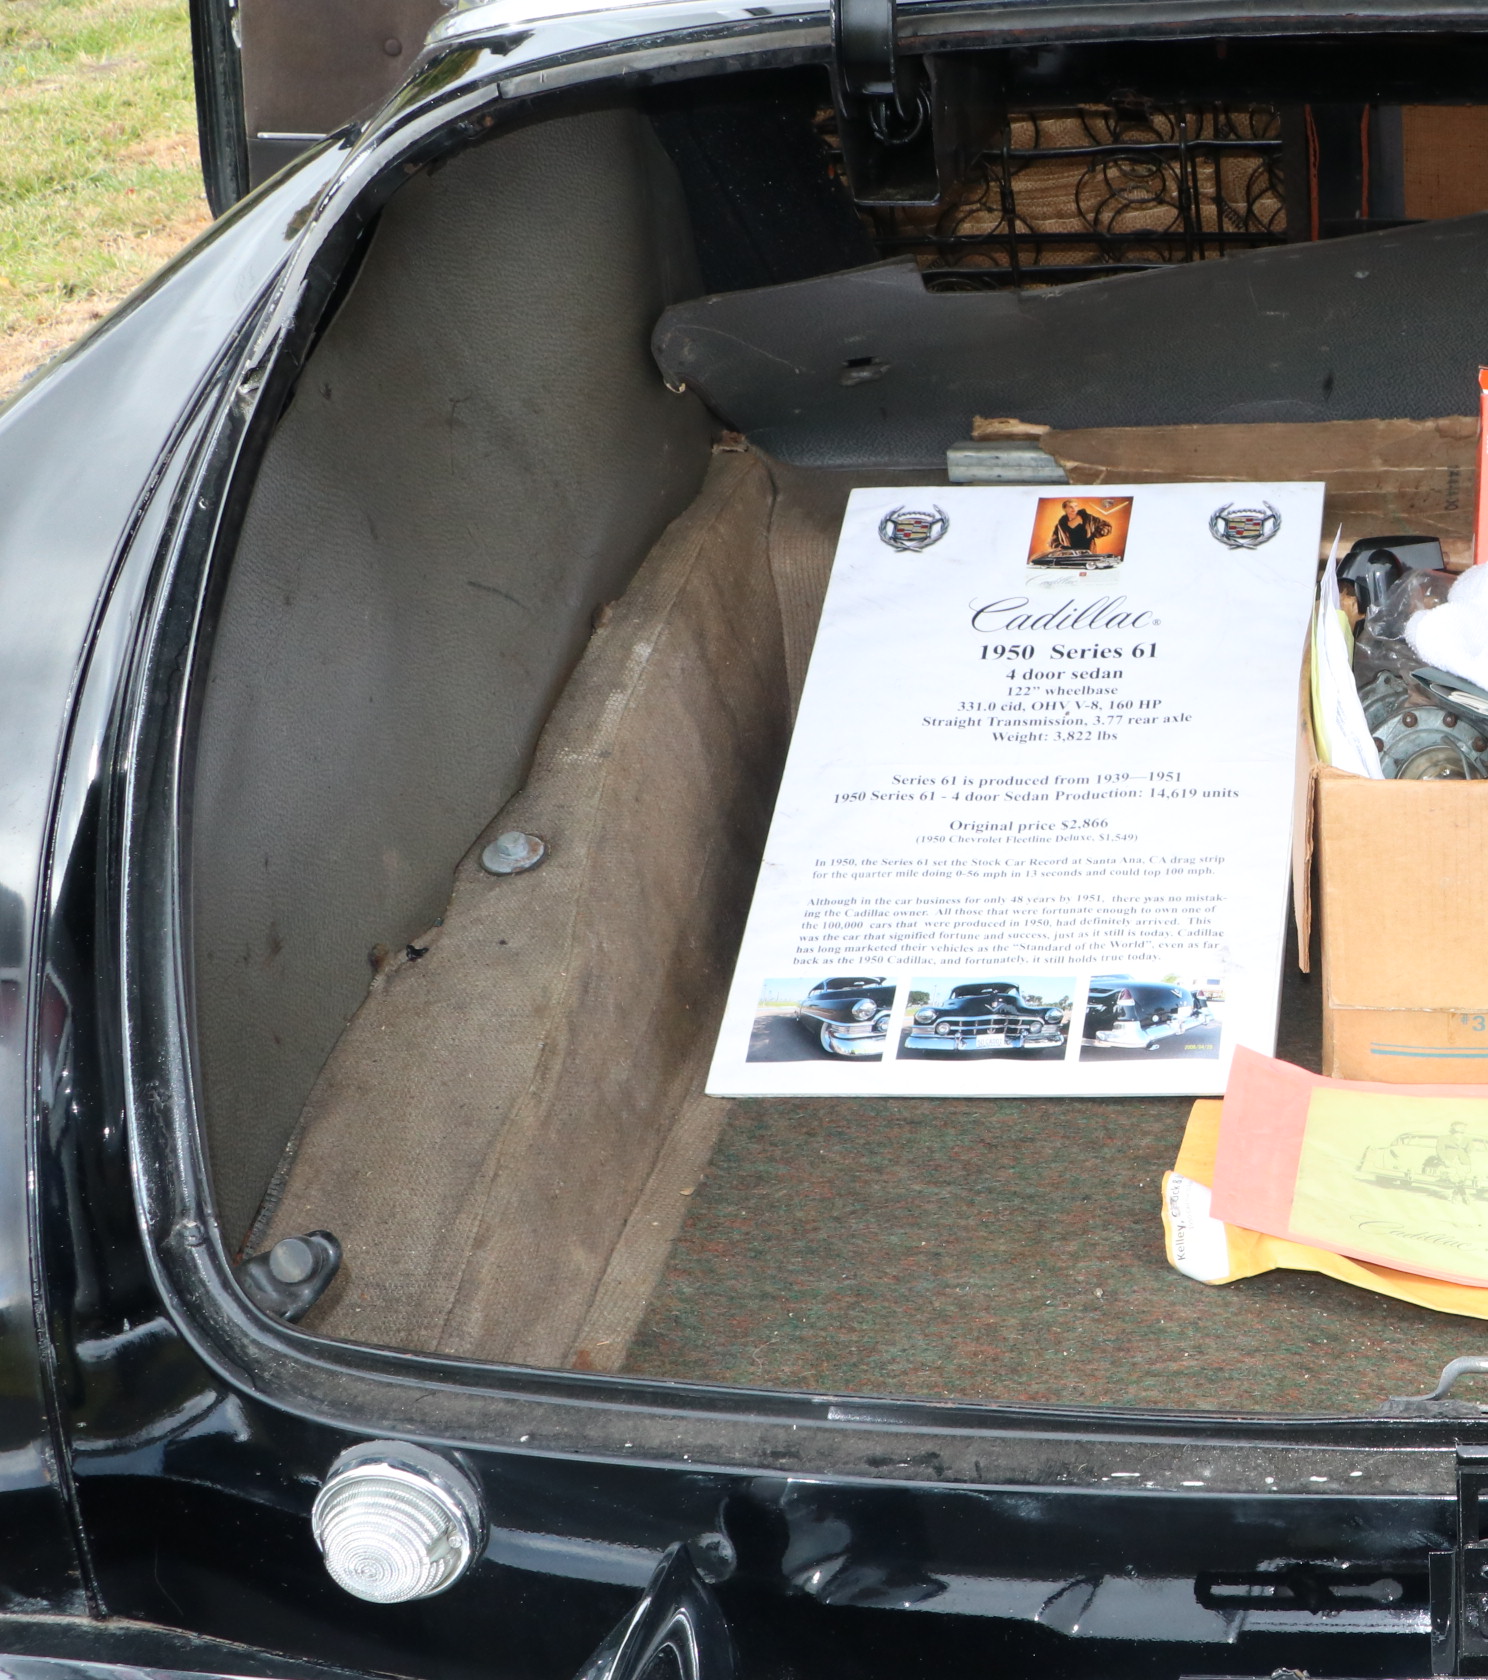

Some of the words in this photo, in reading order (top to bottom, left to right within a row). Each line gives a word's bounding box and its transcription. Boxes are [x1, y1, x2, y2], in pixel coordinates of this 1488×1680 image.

[981, 645, 1034, 660] 1950
[1050, 643, 1122, 659] Series
[1131, 642, 1156, 658] 61
[1006, 669, 1015, 680] 4
[1022, 668, 1065, 680] door
[1071, 667, 1122, 679] sedan
[1045, 685, 1118, 695] wheelbase
[958, 701, 996, 711] 331.0
[1031, 701, 1070, 710] OHV
[1075, 700, 1102, 710] V-8,
[1110, 700, 1133, 709] 160
[1139, 699, 1161, 709] HP
[922, 717, 981, 729] Straight
[989, 716, 1087, 726] Transmission,
[1093, 714, 1123, 725] 3.77
[1163, 712, 1192, 723] axle
[992, 731, 1048, 743] Weight:
[1053, 730, 1092, 742] 3,822
[1097, 731, 1117, 740] lbs
[892, 775, 935, 785] Series
[941, 776, 956, 785] 61
[963, 776, 973, 785] is
[978, 775, 1049, 788] produced
[1054, 775, 1089, 784] from
[834, 792, 866, 803] 1950
[870, 790, 914, 800] Series
[919, 791, 934, 800] 61
[952, 792, 959, 801] 4
[965, 791, 999, 801] door
[1004, 791, 1048, 801] Sedan
[1055, 788, 1142, 800] Production:
[1150, 787, 1197, 799] 14,619
[1202, 788, 1239, 797] units
[949, 820, 1013, 833] Original
[1017, 820, 1055, 834] price
[1061, 818, 1108, 830] $2,866
[915, 835, 945, 844] (1950
[948, 835, 1001, 843] Chevrolet
[1006, 835, 1051, 843] Fleetline
[1055, 834, 1094, 842] Deluxe,
[1099, 833, 1137, 842] $1,549)
[815, 859, 826, 867] In
[831, 858, 857, 866] 1950,
[861, 858, 877, 866] the
[881, 858, 912, 866] Series
[951, 858, 967, 866] the
[971, 858, 1000, 866] Stock
[1029, 857, 1068, 866] Record
[1122, 856, 1144, 864] Ana,
[1170, 856, 1195, 865] drag
[1199, 855, 1225, 865] strip
[812, 870, 828, 879] for
[831, 870, 847, 878] the
[851, 871, 892, 881] quarter
[895, 869, 918, 877] mile
[921, 869, 952, 878] doing
[983, 870, 1006, 879] mph
[1026, 869, 1037, 877] 13
[1041, 869, 1082, 877] seconds
[1086, 868, 1106, 876] and
[1109, 868, 1139, 876] could
[1143, 869, 1161, 878] top
[1187, 866, 1214, 876] mph.
[808, 897, 856, 906] Although
[860, 897, 871, 905] in
[874, 897, 891, 905] the
[983, 896, 1005, 905] only
[1026, 897, 1055, 905] years
[1059, 895, 1070, 904] by
[1077, 894, 1104, 903] 1951,
[1112, 894, 1140, 902] there
[1143, 896, 1164, 904] was
[1185, 894, 1228, 902] mistak-
[804, 910, 821, 919] ing
[824, 909, 841, 917] the
[844, 909, 889, 917] Cadillac
[955, 907, 983, 915] those
[987, 907, 1008, 915] that
[1042, 907, 1093, 915] fortunate
[1096, 906, 1136, 915] enough
[801, 921, 818, 929] the
[823, 921, 863, 930] 100,000
[896, 920, 917, 928] that
[953, 919, 1006, 929] produced
[1009, 919, 1019, 927] in
[1025, 919, 1051, 927] 1950,
[1056, 918, 1076, 926] had
[1079, 917, 1129, 927] definitely
[1189, 917, 1211, 925] This
[822, 933, 839, 941] the
[889, 931, 935, 942] signified
[939, 931, 980, 940] fortune
[983, 931, 1004, 940] and
[1053, 931, 1074, 941] just
[1092, 929, 1099, 937] it
[1140, 929, 1172, 938] today.
[1177, 929, 1224, 937] Cadillac
[1351, 1214, 1477, 1252] Cadillac
[1175, 1220, 1187, 1261] Kelley,
